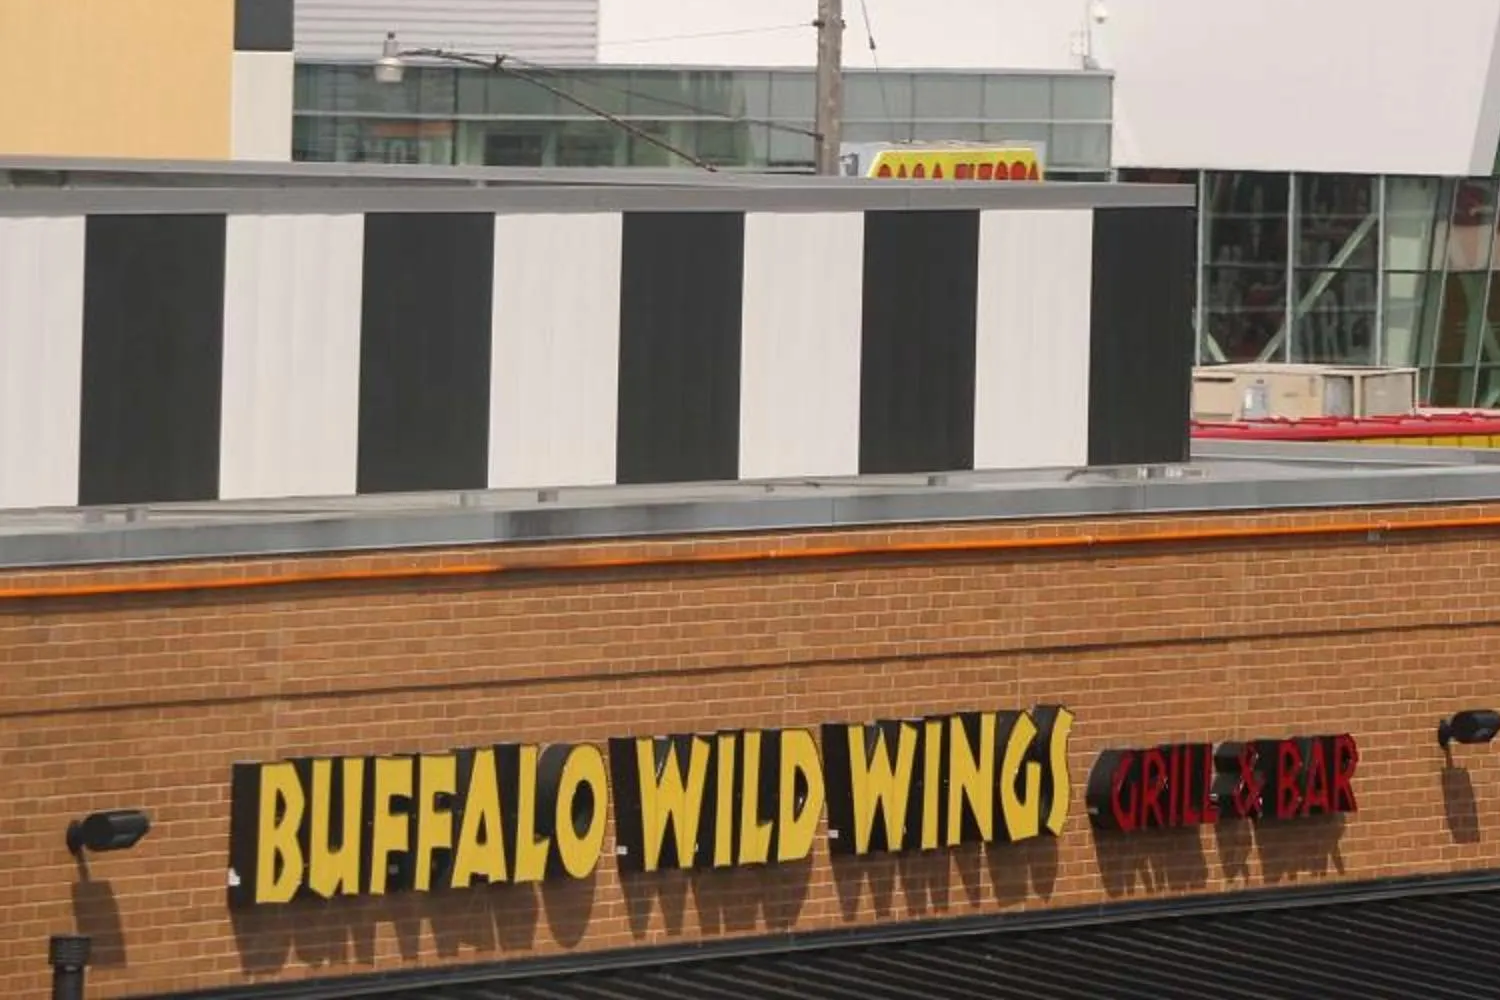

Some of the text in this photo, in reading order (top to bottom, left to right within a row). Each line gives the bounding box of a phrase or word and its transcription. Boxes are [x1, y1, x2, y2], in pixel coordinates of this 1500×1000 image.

[254, 704, 1074, 905] BUFFALO WILD WINGS
[1110, 733, 1359, 834] GRILL & BAR
